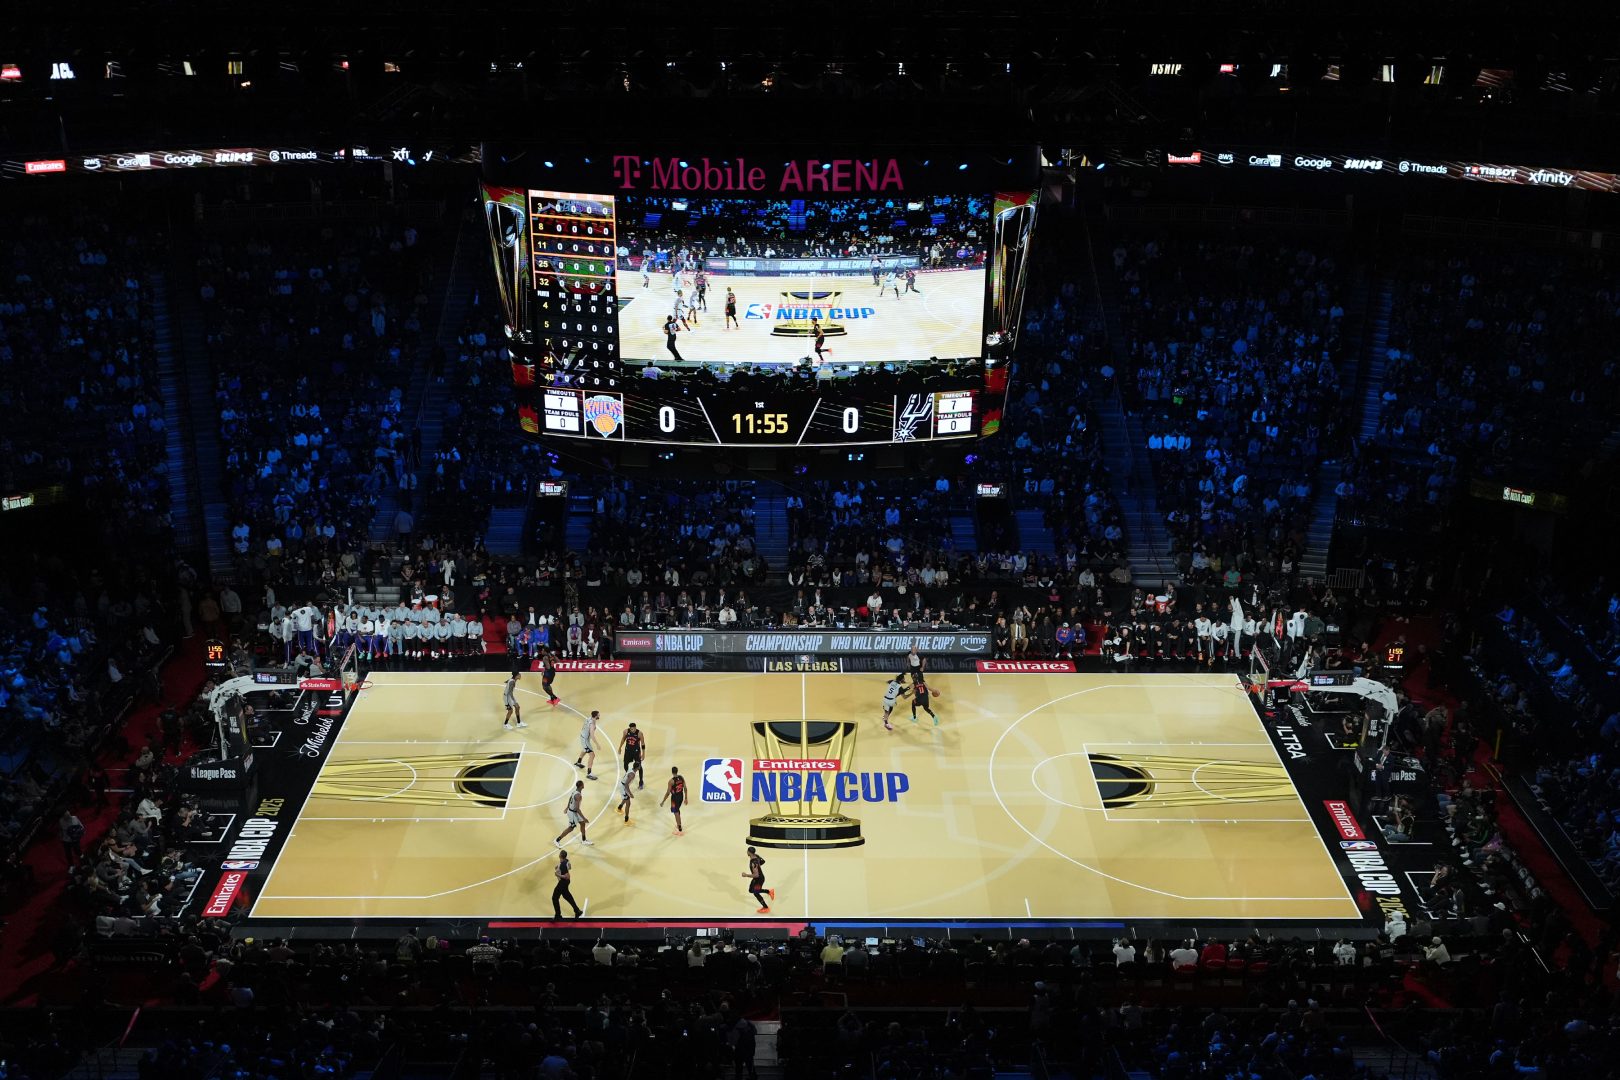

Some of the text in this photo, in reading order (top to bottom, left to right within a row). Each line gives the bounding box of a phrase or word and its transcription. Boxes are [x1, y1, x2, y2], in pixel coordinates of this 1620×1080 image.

[164, 154, 202, 166] Google
[215, 152, 254, 163] SKIMS
[281, 150, 317, 160] Threads
[28, 161, 64, 171] Emirates
[1294, 157, 1332, 170] Google
[1344, 159, 1383, 170] SKIMS
[1411, 163, 1448, 174] Threads
[779, 159, 904, 192] ARENA
[1479, 167, 1518, 176] TISSOT
[1528, 169, 1574, 186] xfinity
[556, 204, 560, 212] 0
[571, 205, 576, 213] 0
[557, 224, 562, 232] 0
[538, 241, 547, 249] 11
[573, 244, 578, 252] 0
[588, 245, 594, 253] 0
[604, 246, 610, 254] 0
[538, 260, 548, 268] 25
[539, 278, 549, 286] 32
[606, 283, 611, 291] 0
[776, 307, 875, 320] NBA CUP
[562, 322, 567, 330] 0
[547, 389, 575, 397] TIMEOUTS
[558, 398, 563, 408] 7
[755, 401, 764, 409] 1st
[951, 400, 956, 410] 7
[561, 410, 579, 418] FOULS
[659, 406, 676, 433] 0
[560, 418, 565, 428] 0
[733, 413, 789, 434] 11:55
[843, 407, 859, 434] 0
[951, 420, 956, 430] 0
[664, 635, 704, 651] NBA CUP
[745, 635, 823, 651] CHAMPIONSHIP
[831, 636, 955, 650] WHO WILL CAPTURE THE CUP?
[960, 636, 987, 647] prime
[209, 652, 221, 660] 21
[1388, 654, 1400, 662] 21
[538, 661, 624, 670] mirates
[769, 661, 838, 672] LAS VEGAS
[982, 662, 1069, 670] Emirates
[759, 760, 836, 770] Emirates
[196, 768, 236, 780] League Pass
[1400, 770, 1416, 781] Pass
[752, 772, 910, 803] NBA CUP
[706, 792, 727, 801] NBA
[255, 798, 285, 817] 2025
[1329, 802, 1359, 838] Emirates
[226, 818, 279, 860] NBA CUP
[1345, 851, 1401, 895] NBA CUP
[206, 873, 241, 914] Emirates
